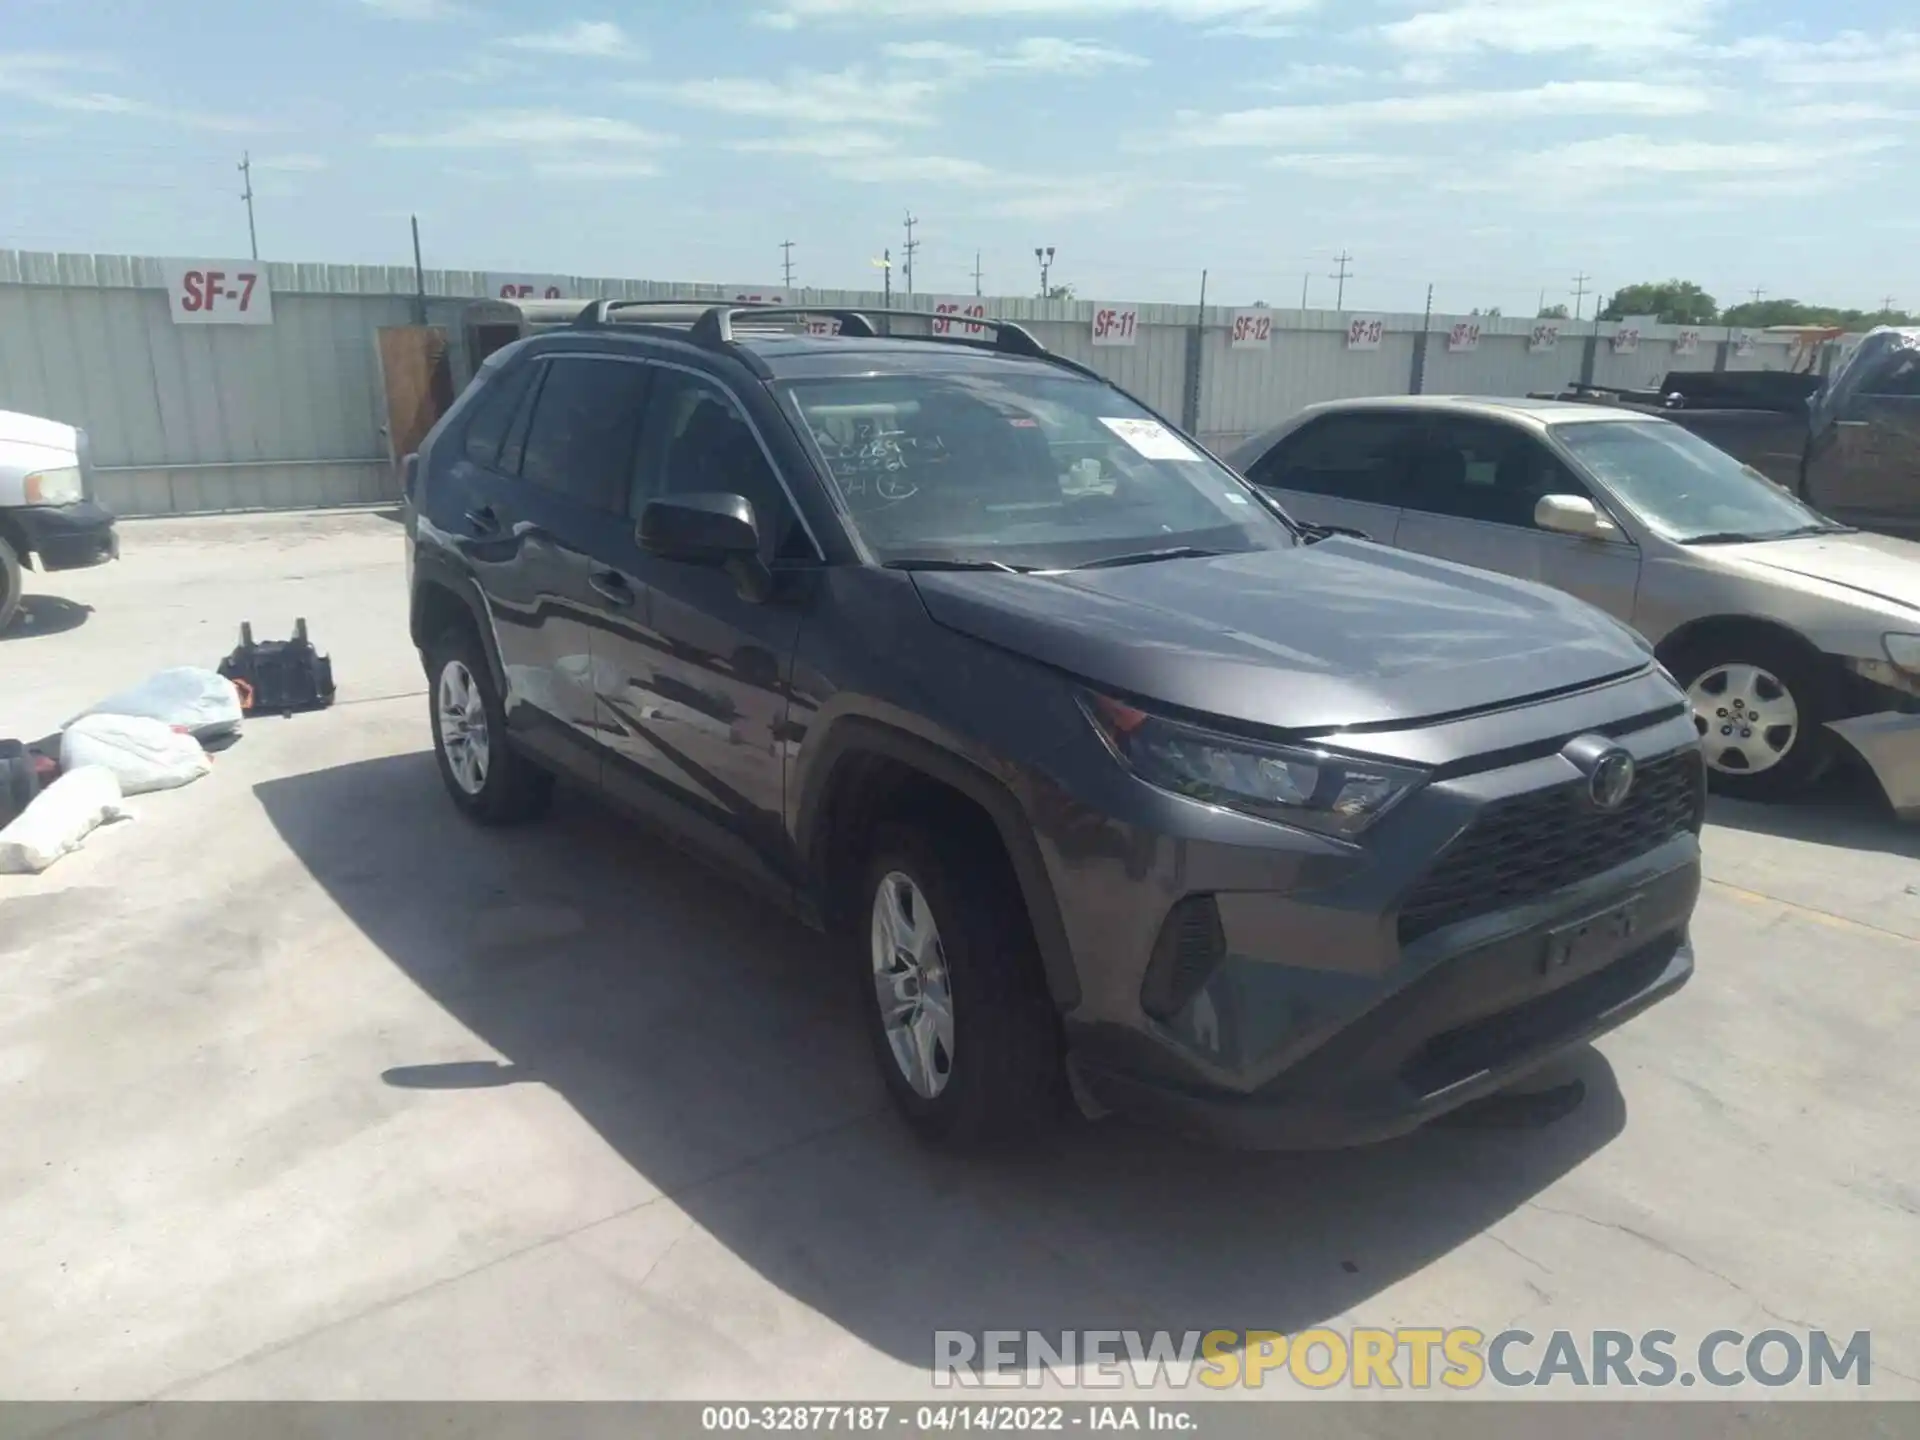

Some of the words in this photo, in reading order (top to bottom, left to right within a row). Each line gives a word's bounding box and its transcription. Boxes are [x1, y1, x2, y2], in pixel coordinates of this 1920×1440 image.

[182, 271, 257, 311] SF-7
[1094, 309, 1136, 338] SF-11
[1234, 316, 1270, 341] SF-12
[1350, 319, 1382, 343] SF-13
